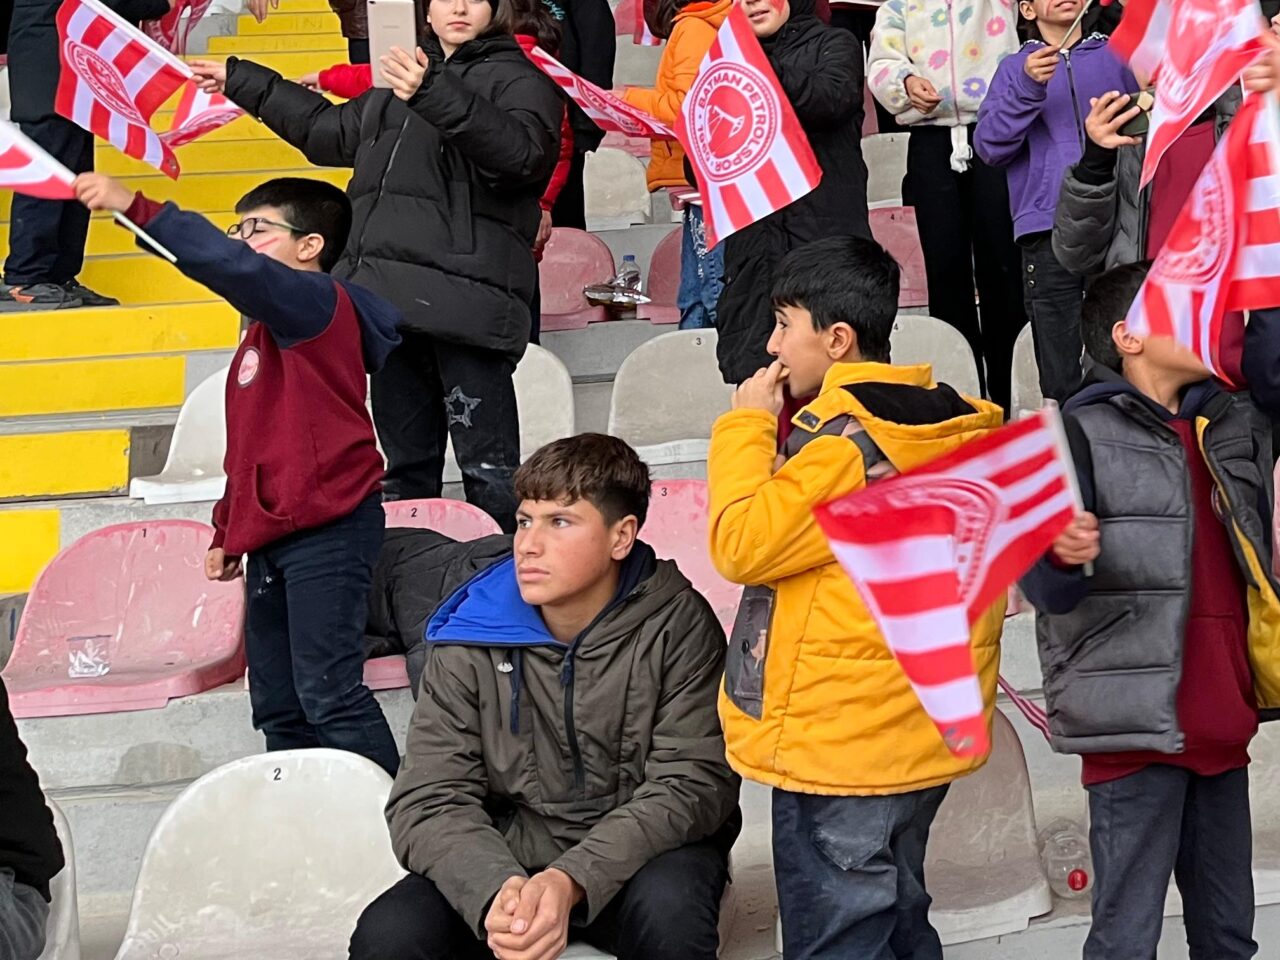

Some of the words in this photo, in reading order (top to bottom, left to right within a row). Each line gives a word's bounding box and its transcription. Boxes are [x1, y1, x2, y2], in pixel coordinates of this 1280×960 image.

[698, 72, 743, 110] BATMAN
[714, 81, 768, 172] PETROLSPOR
[696, 337, 702, 346] 3
[661, 487, 668, 497] 3
[411, 507, 418, 518] 2
[273, 768, 282, 781] 2
